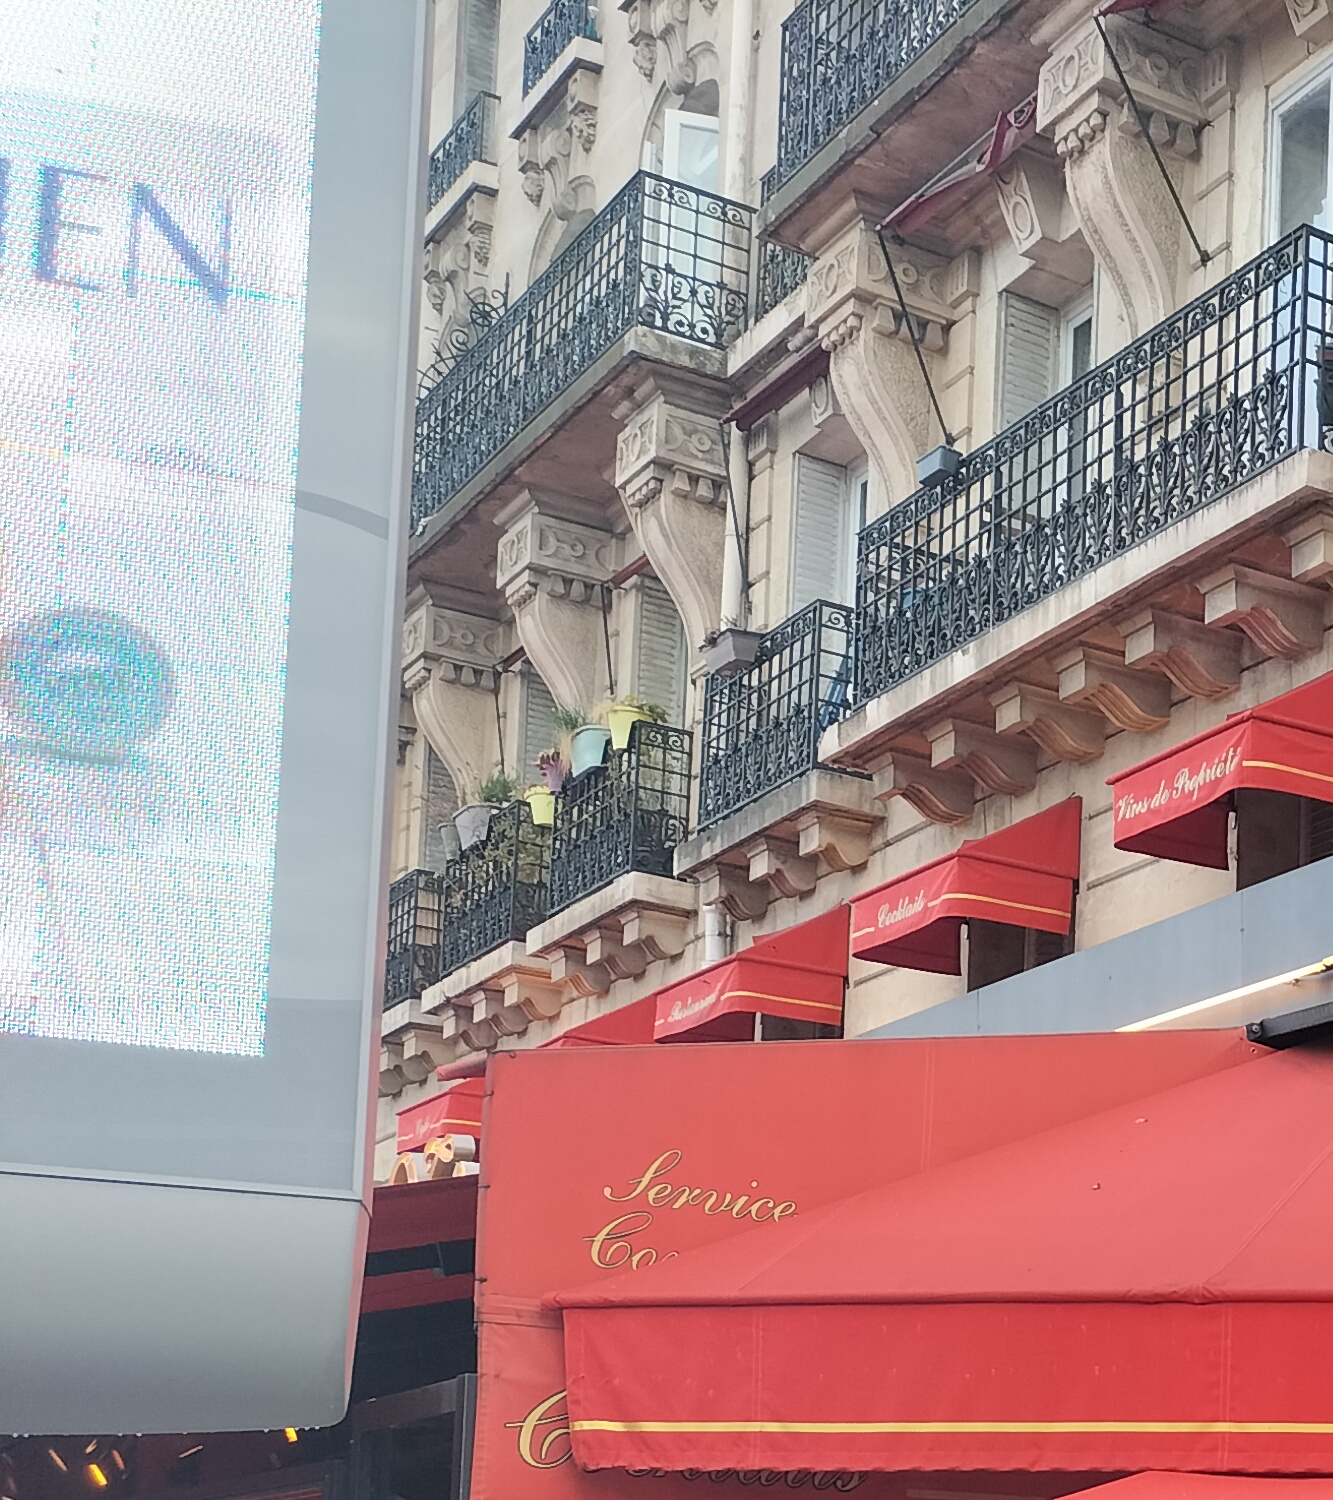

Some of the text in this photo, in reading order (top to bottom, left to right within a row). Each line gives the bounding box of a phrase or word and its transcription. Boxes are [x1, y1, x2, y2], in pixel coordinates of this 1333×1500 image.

[1115, 746, 1242, 822] Vins de Propriété
[877, 889, 926, 928] Cocktails
[603, 1149, 798, 1223] Service
